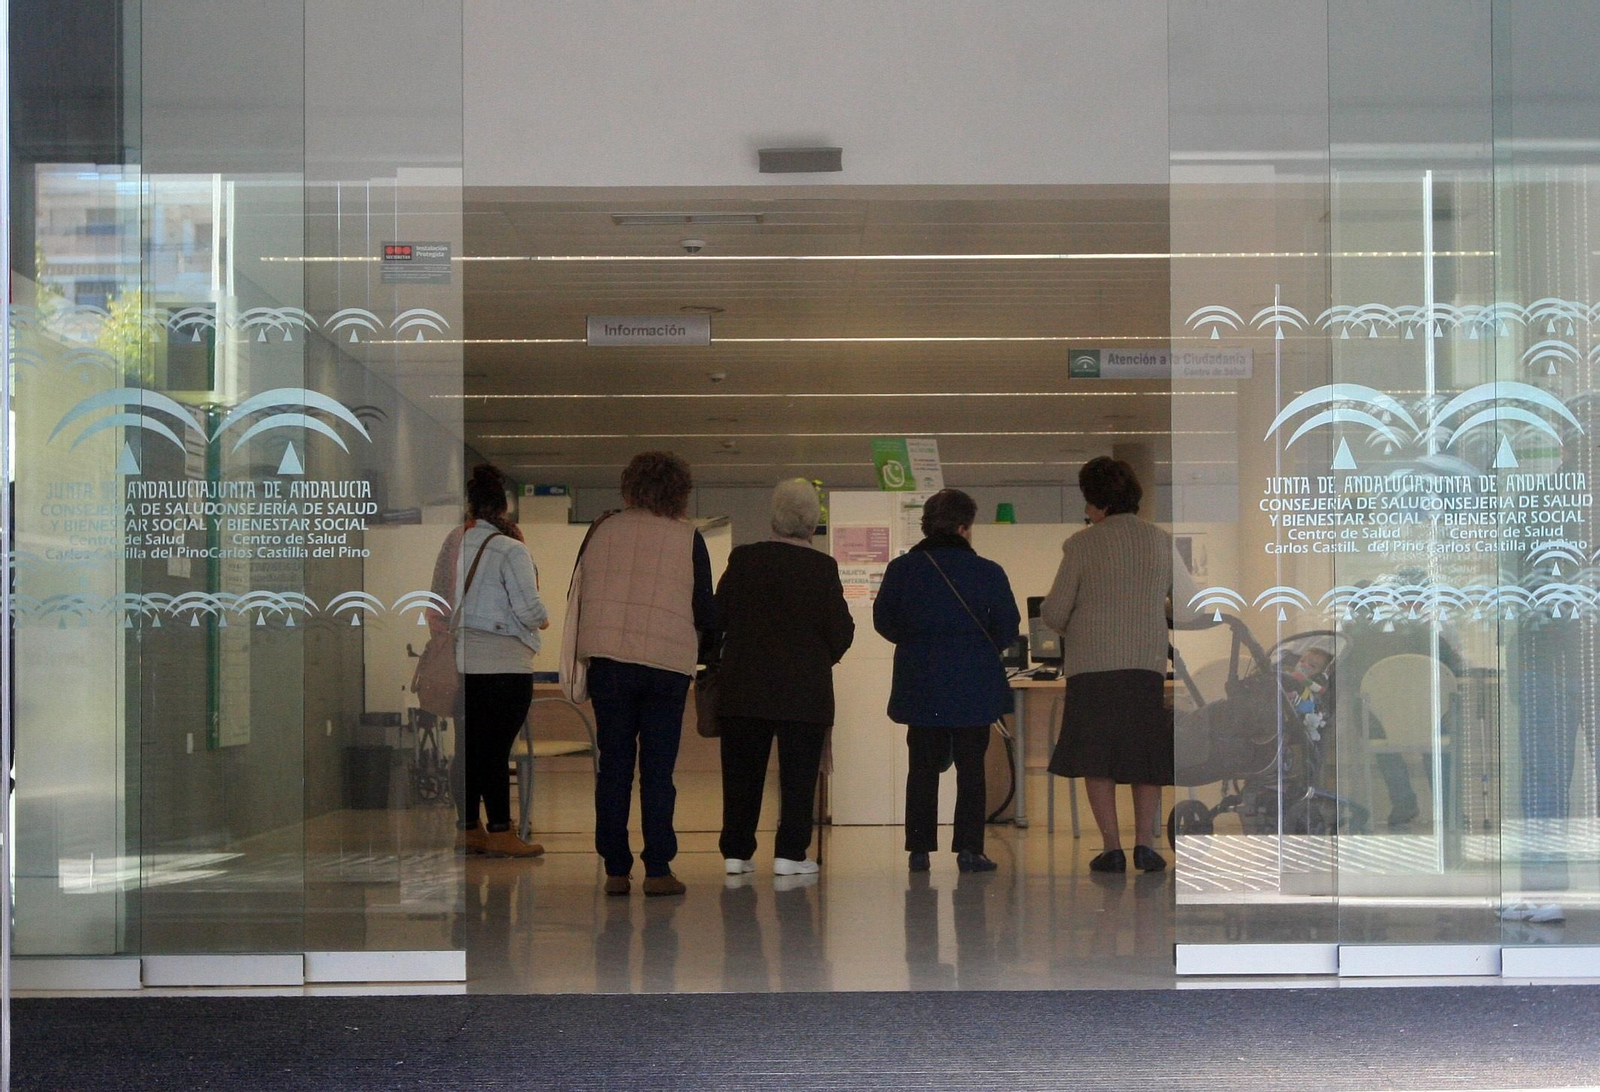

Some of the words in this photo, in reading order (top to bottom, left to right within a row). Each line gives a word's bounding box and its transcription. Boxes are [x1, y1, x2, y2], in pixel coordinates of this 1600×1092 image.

[604, 324, 686, 336] Información
[1108, 353, 1156, 365] Atención
[1160, 356, 1167, 365] a
[127, 480, 209, 499] ANDALUCIA
[209, 480, 256, 499] JUNTA
[263, 480, 282, 498] DE
[290, 480, 371, 498] ANDALUCIA
[1264, 477, 1310, 495] JUNTA
[1317, 476, 1336, 494] DE
[1344, 475, 1424, 493] ANDALUCIA
[1425, 475, 1472, 494] JUNTA
[1479, 474, 1497, 493] DE
[1506, 472, 1587, 492] ANDALUCIA
[303, 502, 323, 515] DE
[327, 501, 378, 515] SALUD
[1259, 495, 1352, 511] CONSEJERÍA
[1357, 497, 1377, 510] DE
[1519, 495, 1539, 508] DE
[1543, 494, 1593, 507] SALUD
[141, 502, 161, 516] DE
[165, 501, 216, 516] SALUD
[152, 518, 207, 532] SOCIAL
[213, 518, 223, 531] Y
[227, 518, 310, 531] BIENESTAR
[314, 518, 370, 531] SOCIAL
[1269, 514, 1279, 527] Y
[1282, 514, 1364, 527] BIENESTAR
[1368, 512, 1422, 525] SOCIAL
[1431, 513, 1441, 526] Y
[1444, 512, 1527, 526] BIENESTAR
[1531, 510, 1586, 523] SOCIAL
[124, 533, 142, 545] de
[145, 533, 185, 545] Salud
[233, 533, 281, 545] Centro
[285, 533, 304, 545] de
[307, 533, 347, 545] Salud
[1288, 529, 1336, 540] Centro
[1340, 528, 1358, 539] de
[1362, 527, 1401, 539] Salud
[1450, 528, 1498, 539] Centro
[1503, 526, 1521, 538] de
[1525, 525, 1564, 537] Salud
[150, 547, 172, 559] del
[177, 547, 209, 559] Pino
[209, 547, 253, 559] Carlos
[257, 547, 308, 559] Castilla
[312, 547, 334, 558] del
[338, 547, 370, 558] Pino
[1265, 542, 1309, 554] Carlos
[1312, 542, 1361, 553] Castill
[1367, 541, 1389, 552] del
[1393, 541, 1424, 552] Pino
[1427, 541, 1471, 553] Carlos
[1474, 540, 1526, 553] Castilla
